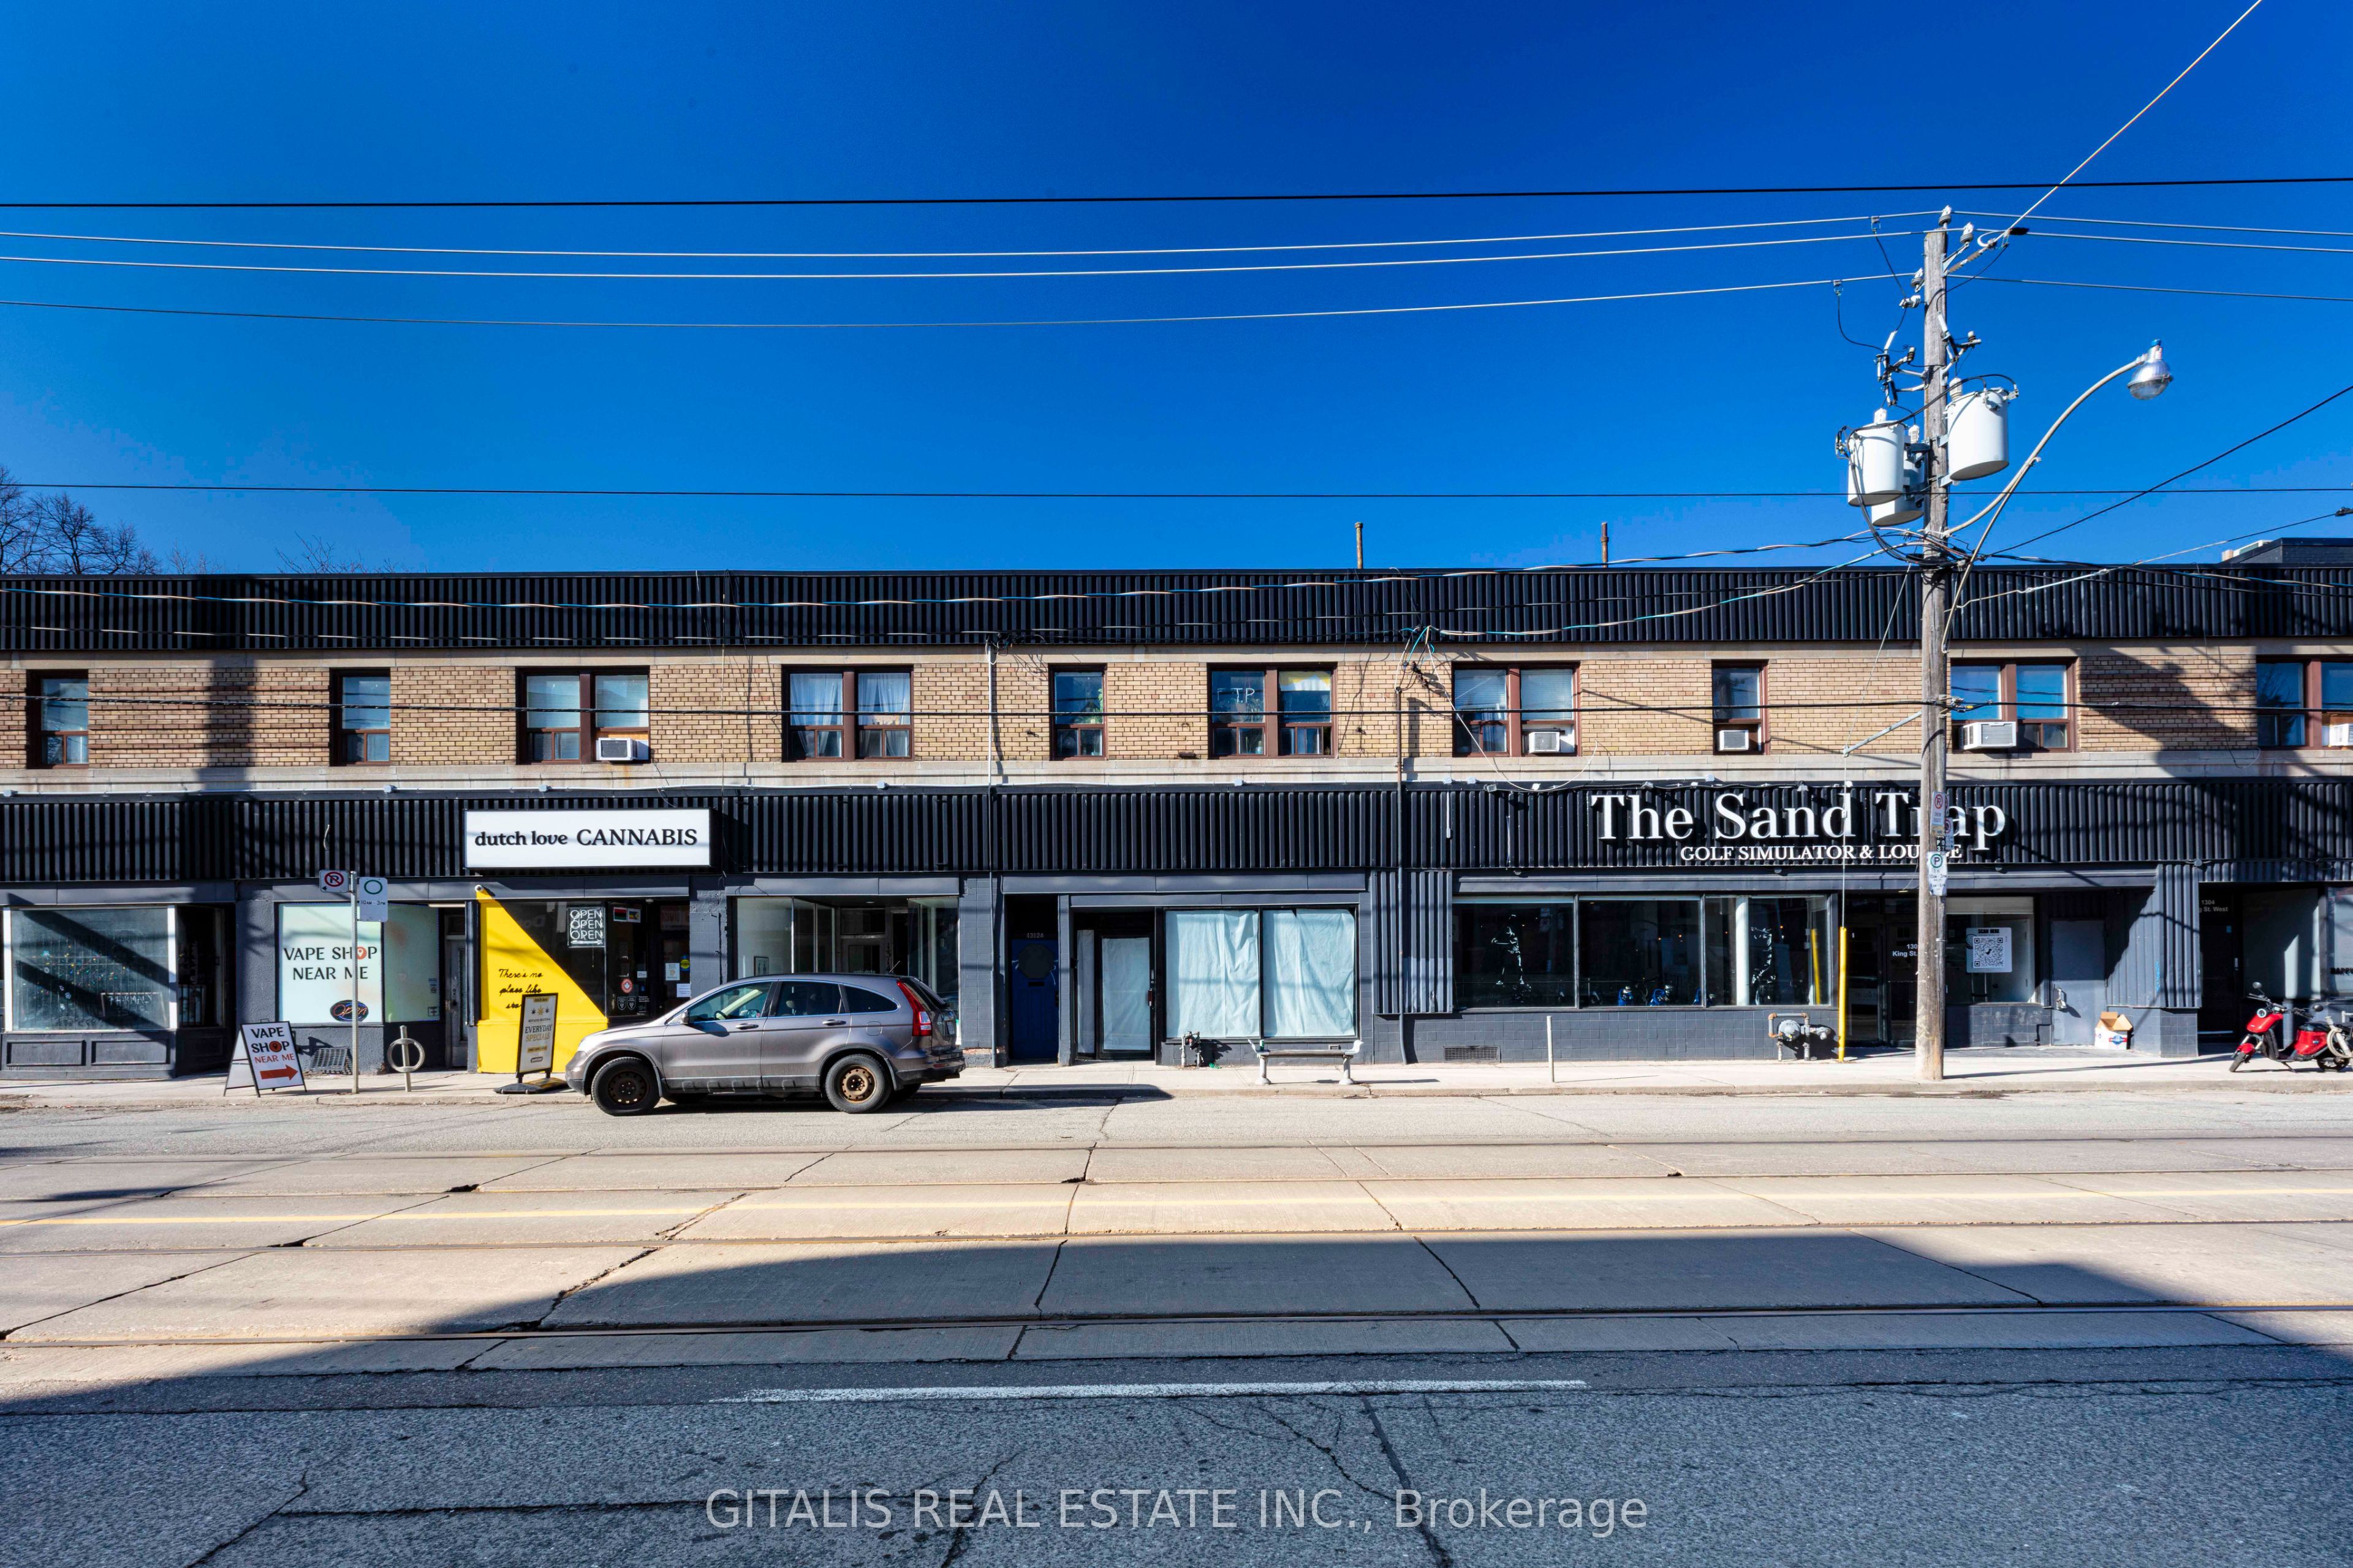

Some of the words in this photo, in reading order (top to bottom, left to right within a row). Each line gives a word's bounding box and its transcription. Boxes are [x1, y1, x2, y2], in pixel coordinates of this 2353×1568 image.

[1591, 794, 1694, 840] The
[1715, 793, 1857, 840] Sand
[474, 831, 528, 847] dutch
[531, 830, 568, 845] love
[577, 828, 698, 846] CANNABIS
[1680, 846, 1734, 861] GOLF
[1738, 844, 1859, 860] SIMULATOR
[1859, 844, 1874, 859] &
[1879, 844, 1962, 859] LOUE
[570, 909, 603, 919] OPEN
[570, 920, 603, 930] OPEN
[284, 947, 325, 960] VAPE
[332, 946, 377, 960] SHOP
[293, 967, 336, 980] NEAR
[344, 966, 368, 979] ME
[499, 968, 528, 978] There's
[499, 983, 523, 997] place
[525, 983, 542, 993] like
[333, 1003, 368, 1017] Opn
[250, 1027, 285, 1039] VAPE
[525, 1024, 553, 1034] EVERYDAY
[526, 1032, 550, 1042] SPECIALS
[251, 1040, 290, 1053] SHOP
[254, 1055, 279, 1064] NEAR
